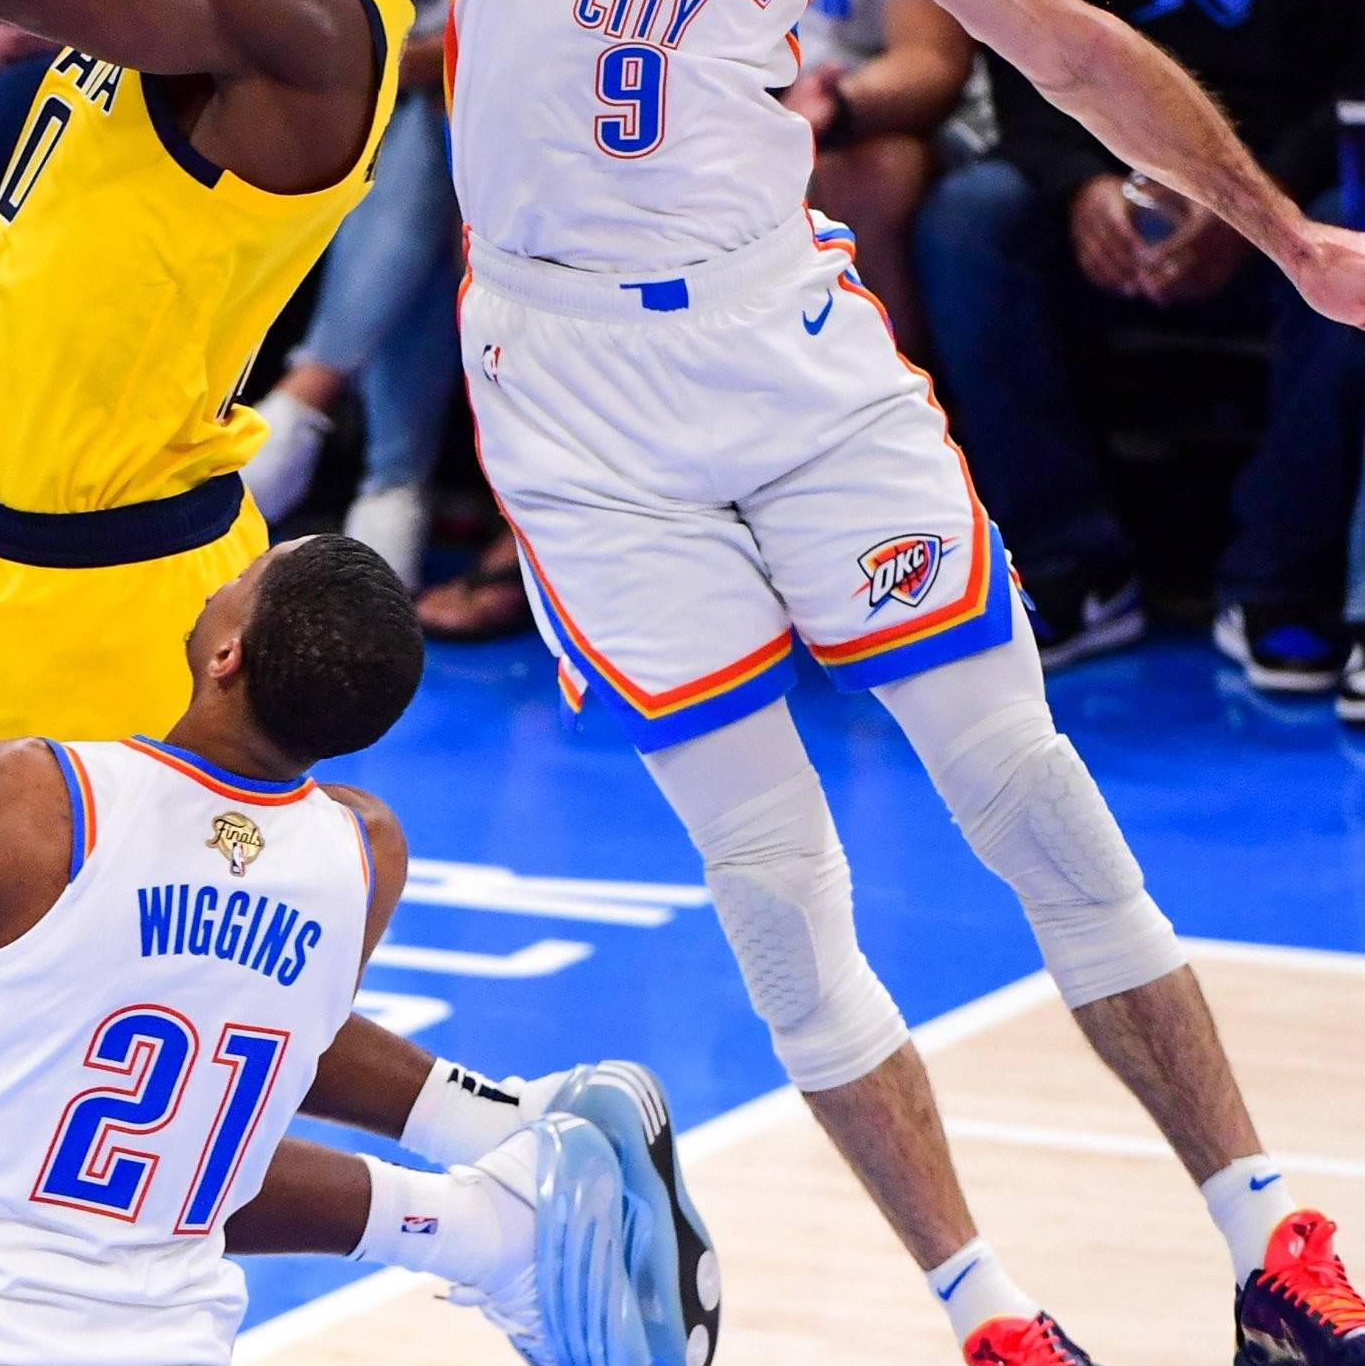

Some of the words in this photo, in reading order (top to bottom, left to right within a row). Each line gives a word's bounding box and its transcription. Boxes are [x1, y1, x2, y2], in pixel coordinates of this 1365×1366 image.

[594, 41, 668, 159] 9
[870, 541, 925, 607] OKC
[206, 818, 263, 847] Finals
[137, 884, 322, 987] WIGGINS
[29, 1004, 291, 1235] 21
